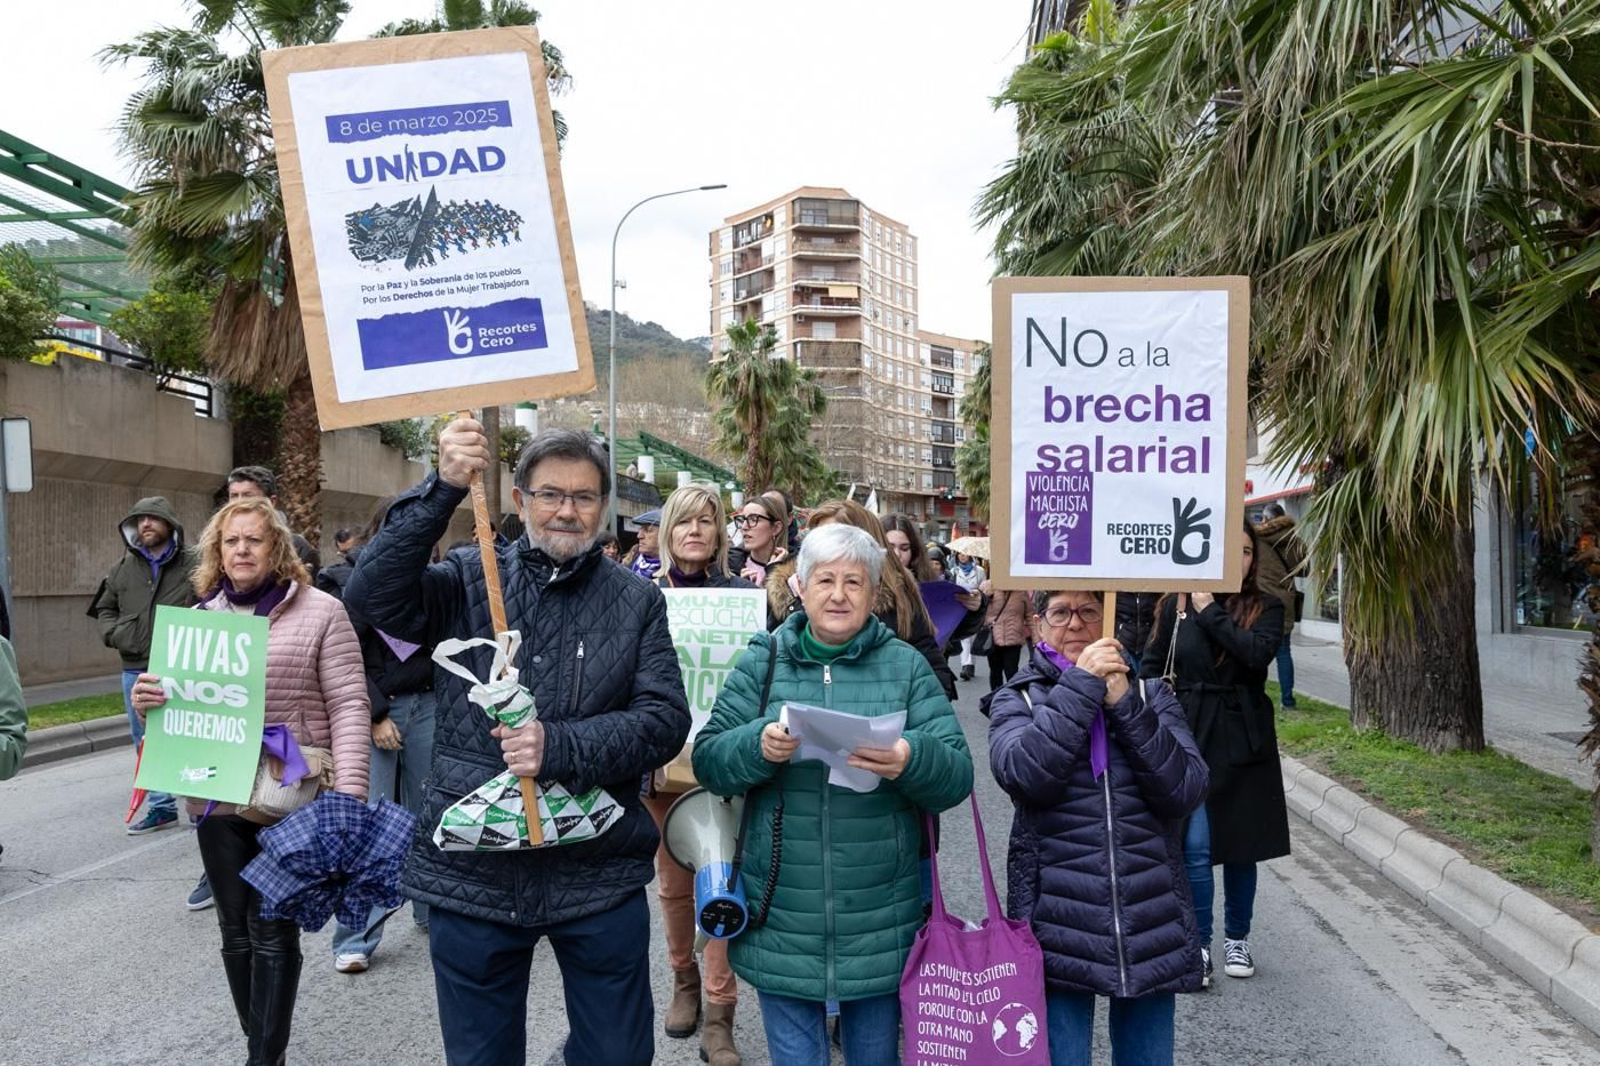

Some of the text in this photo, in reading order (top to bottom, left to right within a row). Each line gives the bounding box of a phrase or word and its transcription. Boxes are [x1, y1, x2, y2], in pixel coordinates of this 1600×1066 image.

[340, 108, 499, 136] 8 de marzo 2025
[345, 144, 506, 184] UNIDAD
[403, 281, 409, 289] y
[476, 271, 488, 279] los
[489, 267, 521, 279] pueblos
[363, 296, 377, 304] Por
[379, 295, 391, 303] los
[393, 290, 433, 301] Derechos
[447, 286, 455, 294] la
[457, 284, 479, 294] Mujer
[481, 279, 529, 291] Trabajadora
[478, 322, 537, 338] Recortes
[479, 336, 514, 348] Cero
[1117, 347, 1136, 368] a
[1146, 340, 1170, 367] la
[1044, 384, 1211, 423] brecha
[1036, 435, 1210, 474] salarial
[1029, 475, 1090, 492] VIOLENCIA
[1030, 495, 1088, 512] MACHISTA
[1037, 513, 1079, 529] CERO
[1107, 523, 1172, 536] RECORTES
[1120, 537, 1171, 555] CERO
[667, 595, 758, 609] MUJER
[668, 608, 759, 628] ESCUCHA
[168, 624, 251, 677] VIVAS
[161, 676, 249, 708] NOS
[164, 708, 247, 744] QUEREMOS
[920, 963, 936, 977] LAS
[919, 982, 931, 996] LA
[932, 983, 960, 1001] MITAD
[976, 986, 1001, 1005] CIELO
[918, 1002, 988, 1025] PORQUE CON LA
[918, 1021, 973, 1043] OTRA MANO
[917, 1040, 967, 1060] SOSTIENEN
